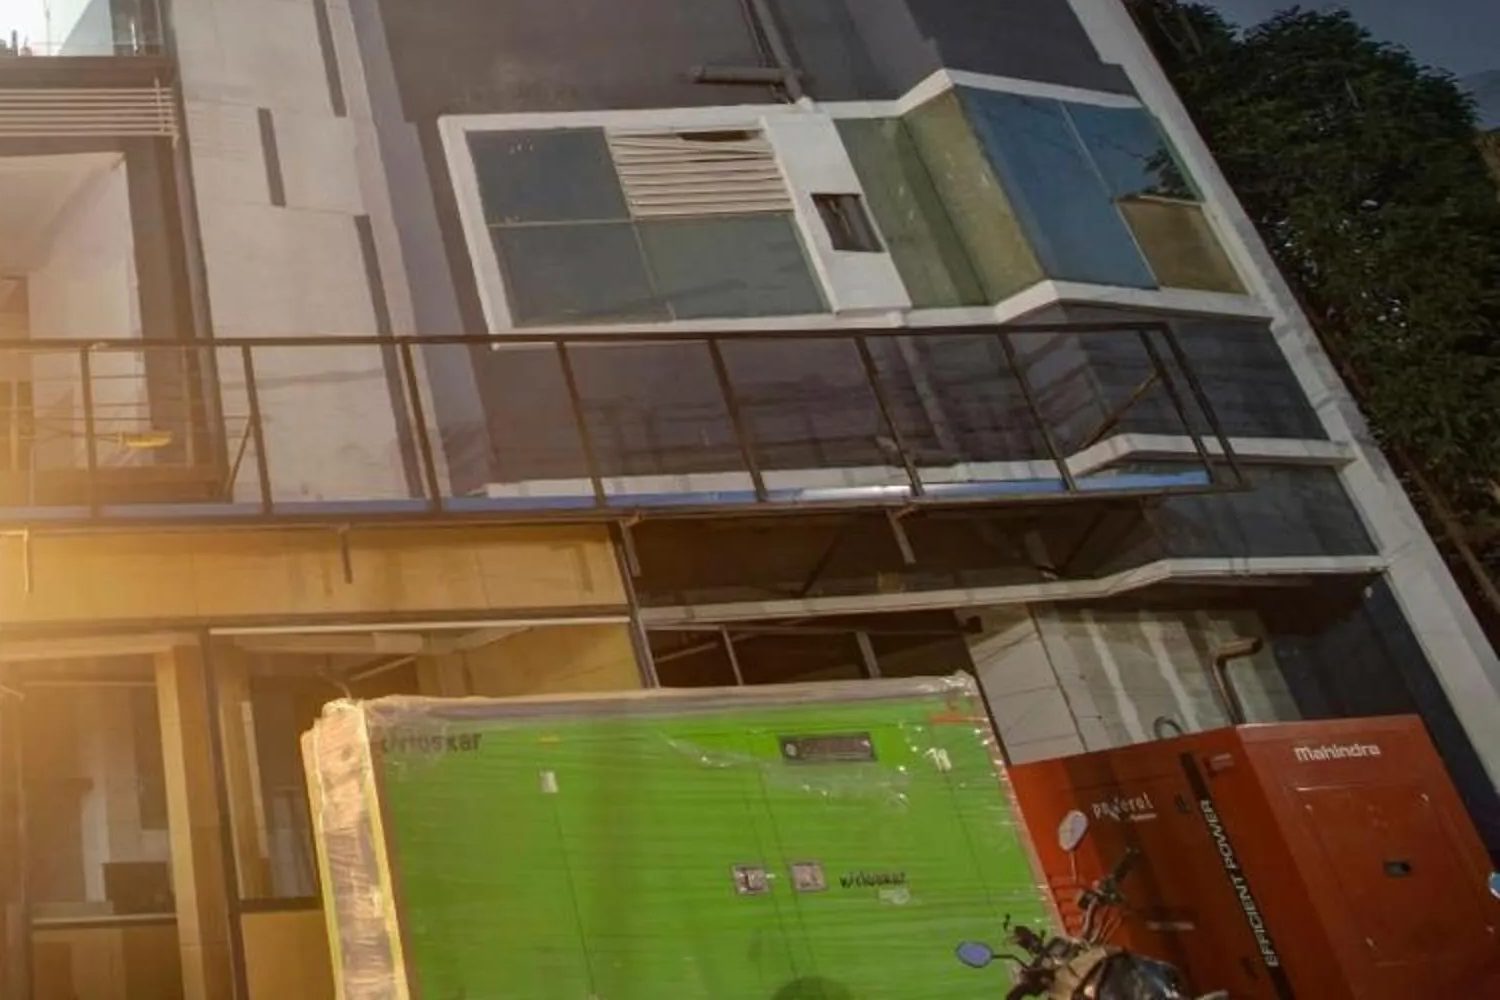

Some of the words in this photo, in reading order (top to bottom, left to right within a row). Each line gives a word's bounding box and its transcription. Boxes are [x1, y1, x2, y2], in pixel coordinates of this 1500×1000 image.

[1294, 743, 1381, 762] Mahindra
[1200, 799, 1238, 869] POWER
[1231, 875, 1279, 967] EFFICIENT
